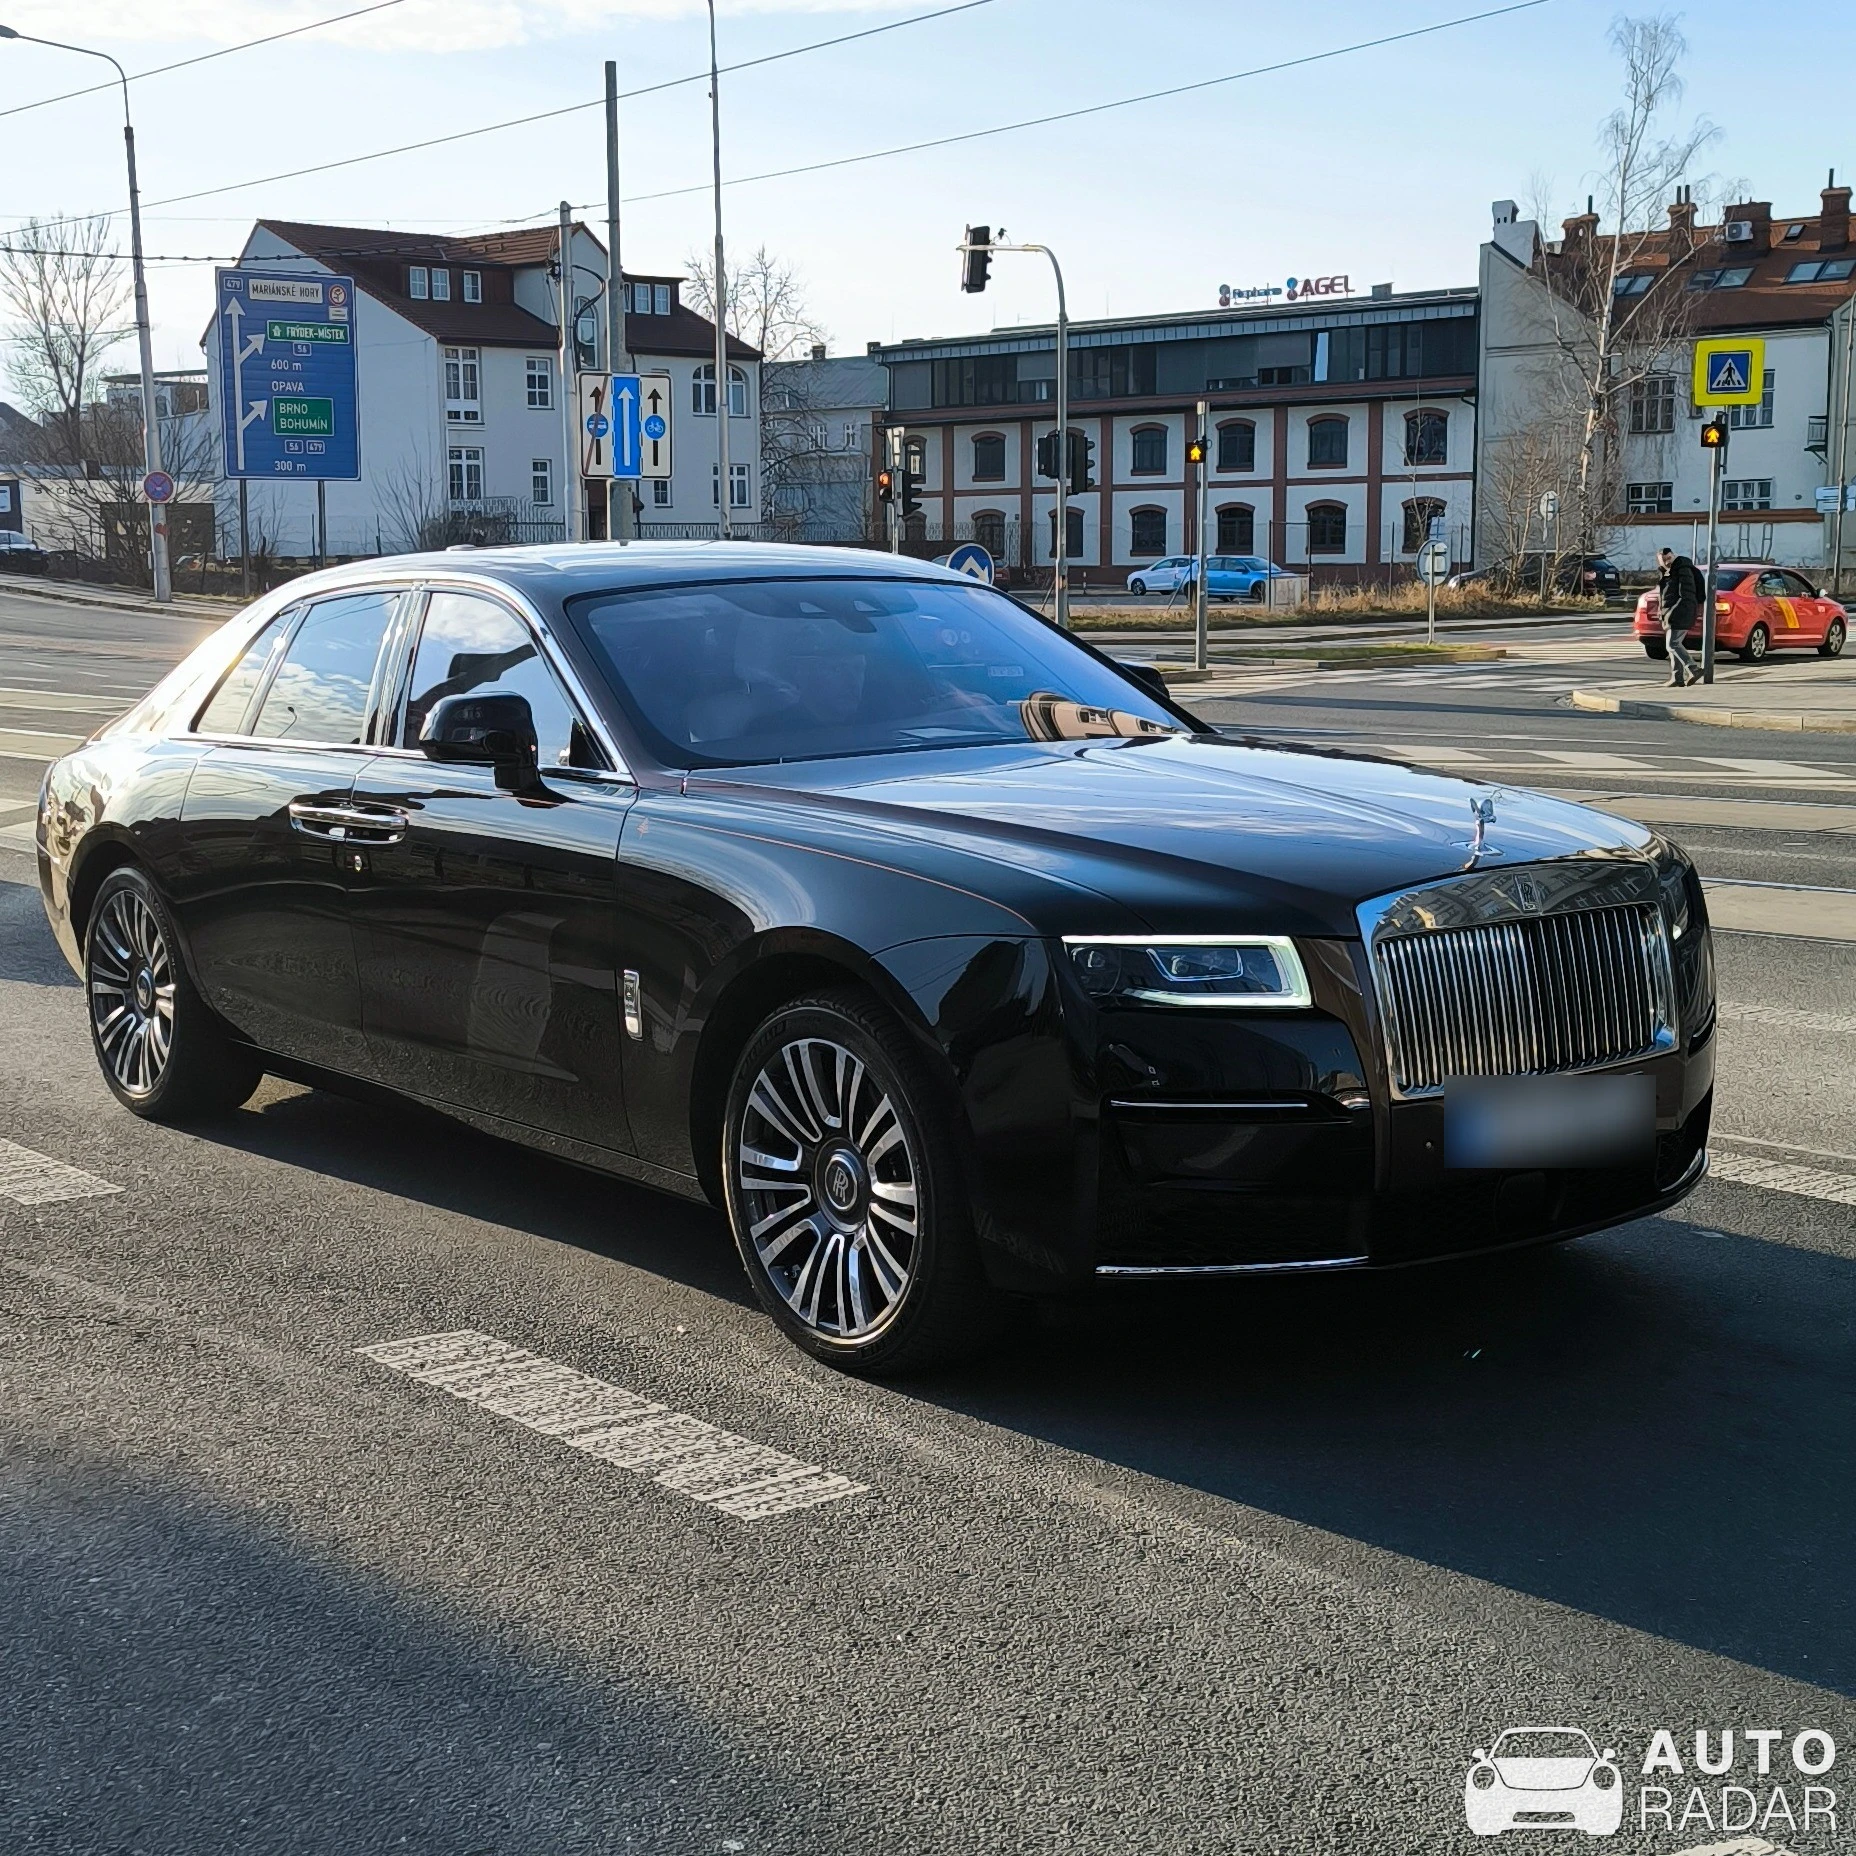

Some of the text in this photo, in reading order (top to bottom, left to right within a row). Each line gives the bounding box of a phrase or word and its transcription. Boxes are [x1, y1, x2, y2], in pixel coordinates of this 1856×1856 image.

[252, 283, 320, 297] MARIÁNSKÉ HORY
[1299, 274, 1355, 296] AGEL
[286, 325, 346, 340] FRÝDEK-MÍSTEK
[271, 359, 302, 371] 600 m
[271, 380, 305, 392] OPAVA
[279, 403, 308, 415] BRNO
[280, 416, 328, 430] BOHUMÍN
[289, 442, 299, 451] 56
[274, 460, 307, 472] 300 m
